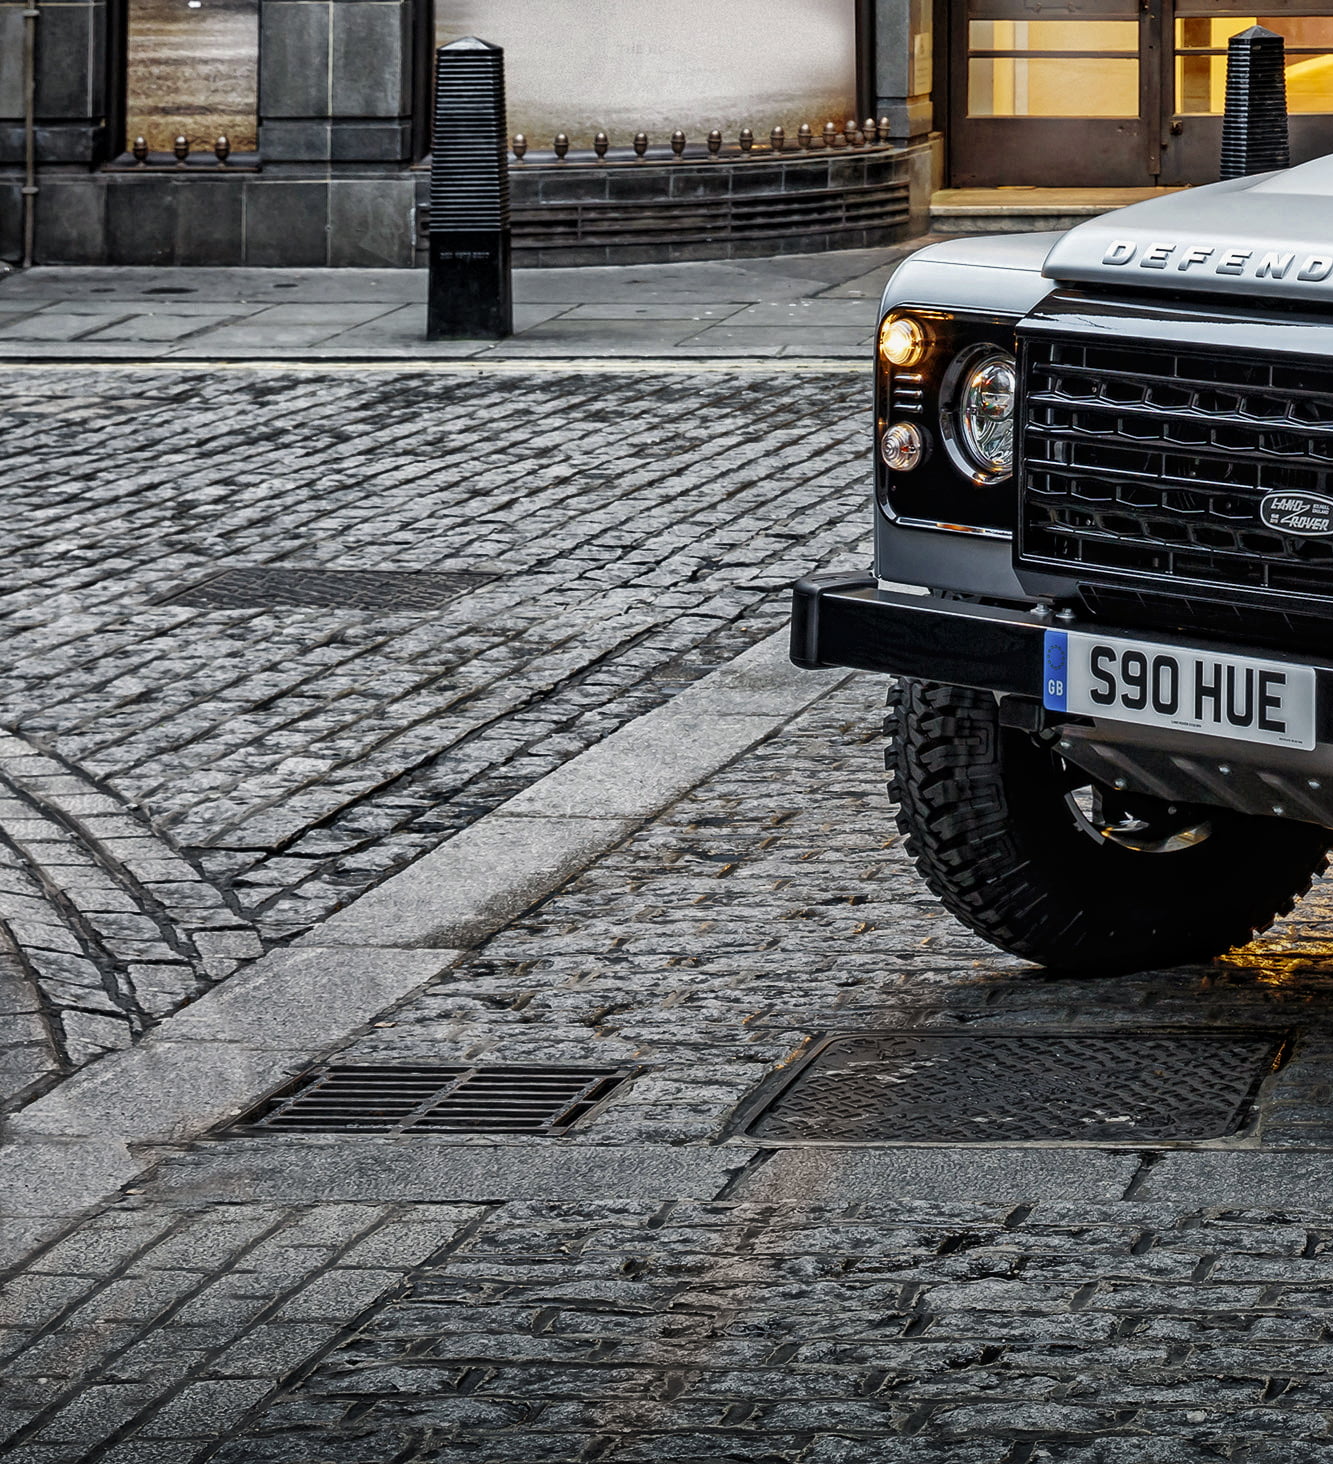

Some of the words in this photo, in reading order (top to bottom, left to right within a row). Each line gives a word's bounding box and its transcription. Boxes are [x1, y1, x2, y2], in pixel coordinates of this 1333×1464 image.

[1270, 497, 1304, 512] LAND
[1289, 515, 1330, 532] ROVER
[1047, 679, 1064, 697] GB
[1089, 644, 1180, 716] S90
[1194, 659, 1288, 734] HUE
